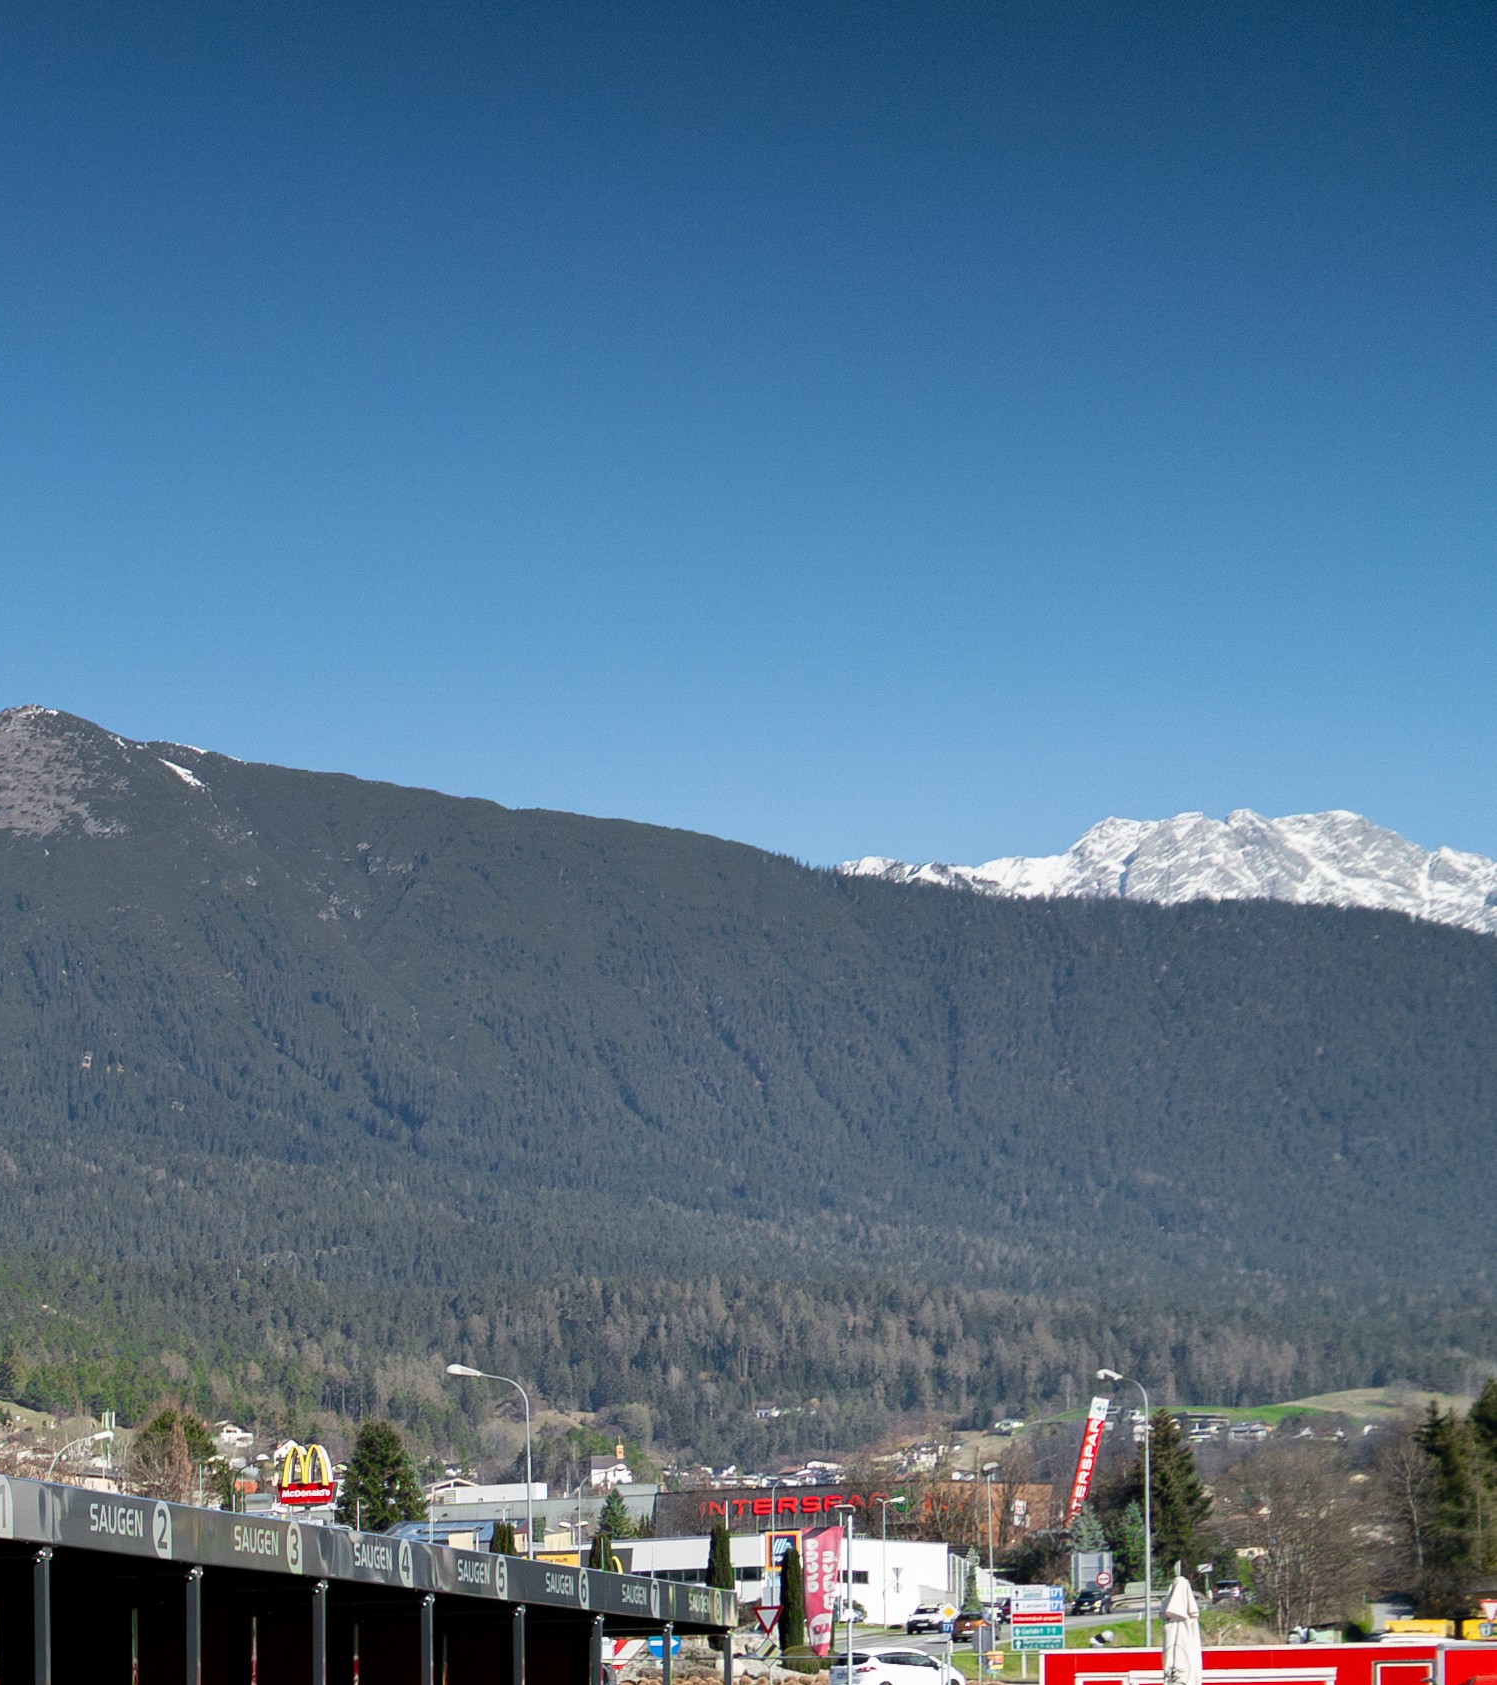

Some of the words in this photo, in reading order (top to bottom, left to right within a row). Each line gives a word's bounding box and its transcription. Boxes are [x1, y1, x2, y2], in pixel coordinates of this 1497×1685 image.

[1070, 1419, 1102, 1519] TERSPAR
[282, 1489, 331, 1498] McDonald's
[89, 1503, 144, 1538] SAUGEN
[156, 1508, 169, 1550] 2
[234, 1525, 278, 1557] SAUGEN
[289, 1528, 300, 1567] 3
[354, 1541, 393, 1572] SAUGEN
[400, 1544, 410, 1581] 4
[457, 1557, 490, 1585] SAUGEN
[498, 1559, 506, 1594] 5
[545, 1572, 574, 1596] SAUGEN
[581, 1572, 589, 1604] 6
[1051, 1587, 1063, 1596] 171
[621, 1583, 647, 1606] SAUGEN
[1051, 1601, 1063, 1610] 171
